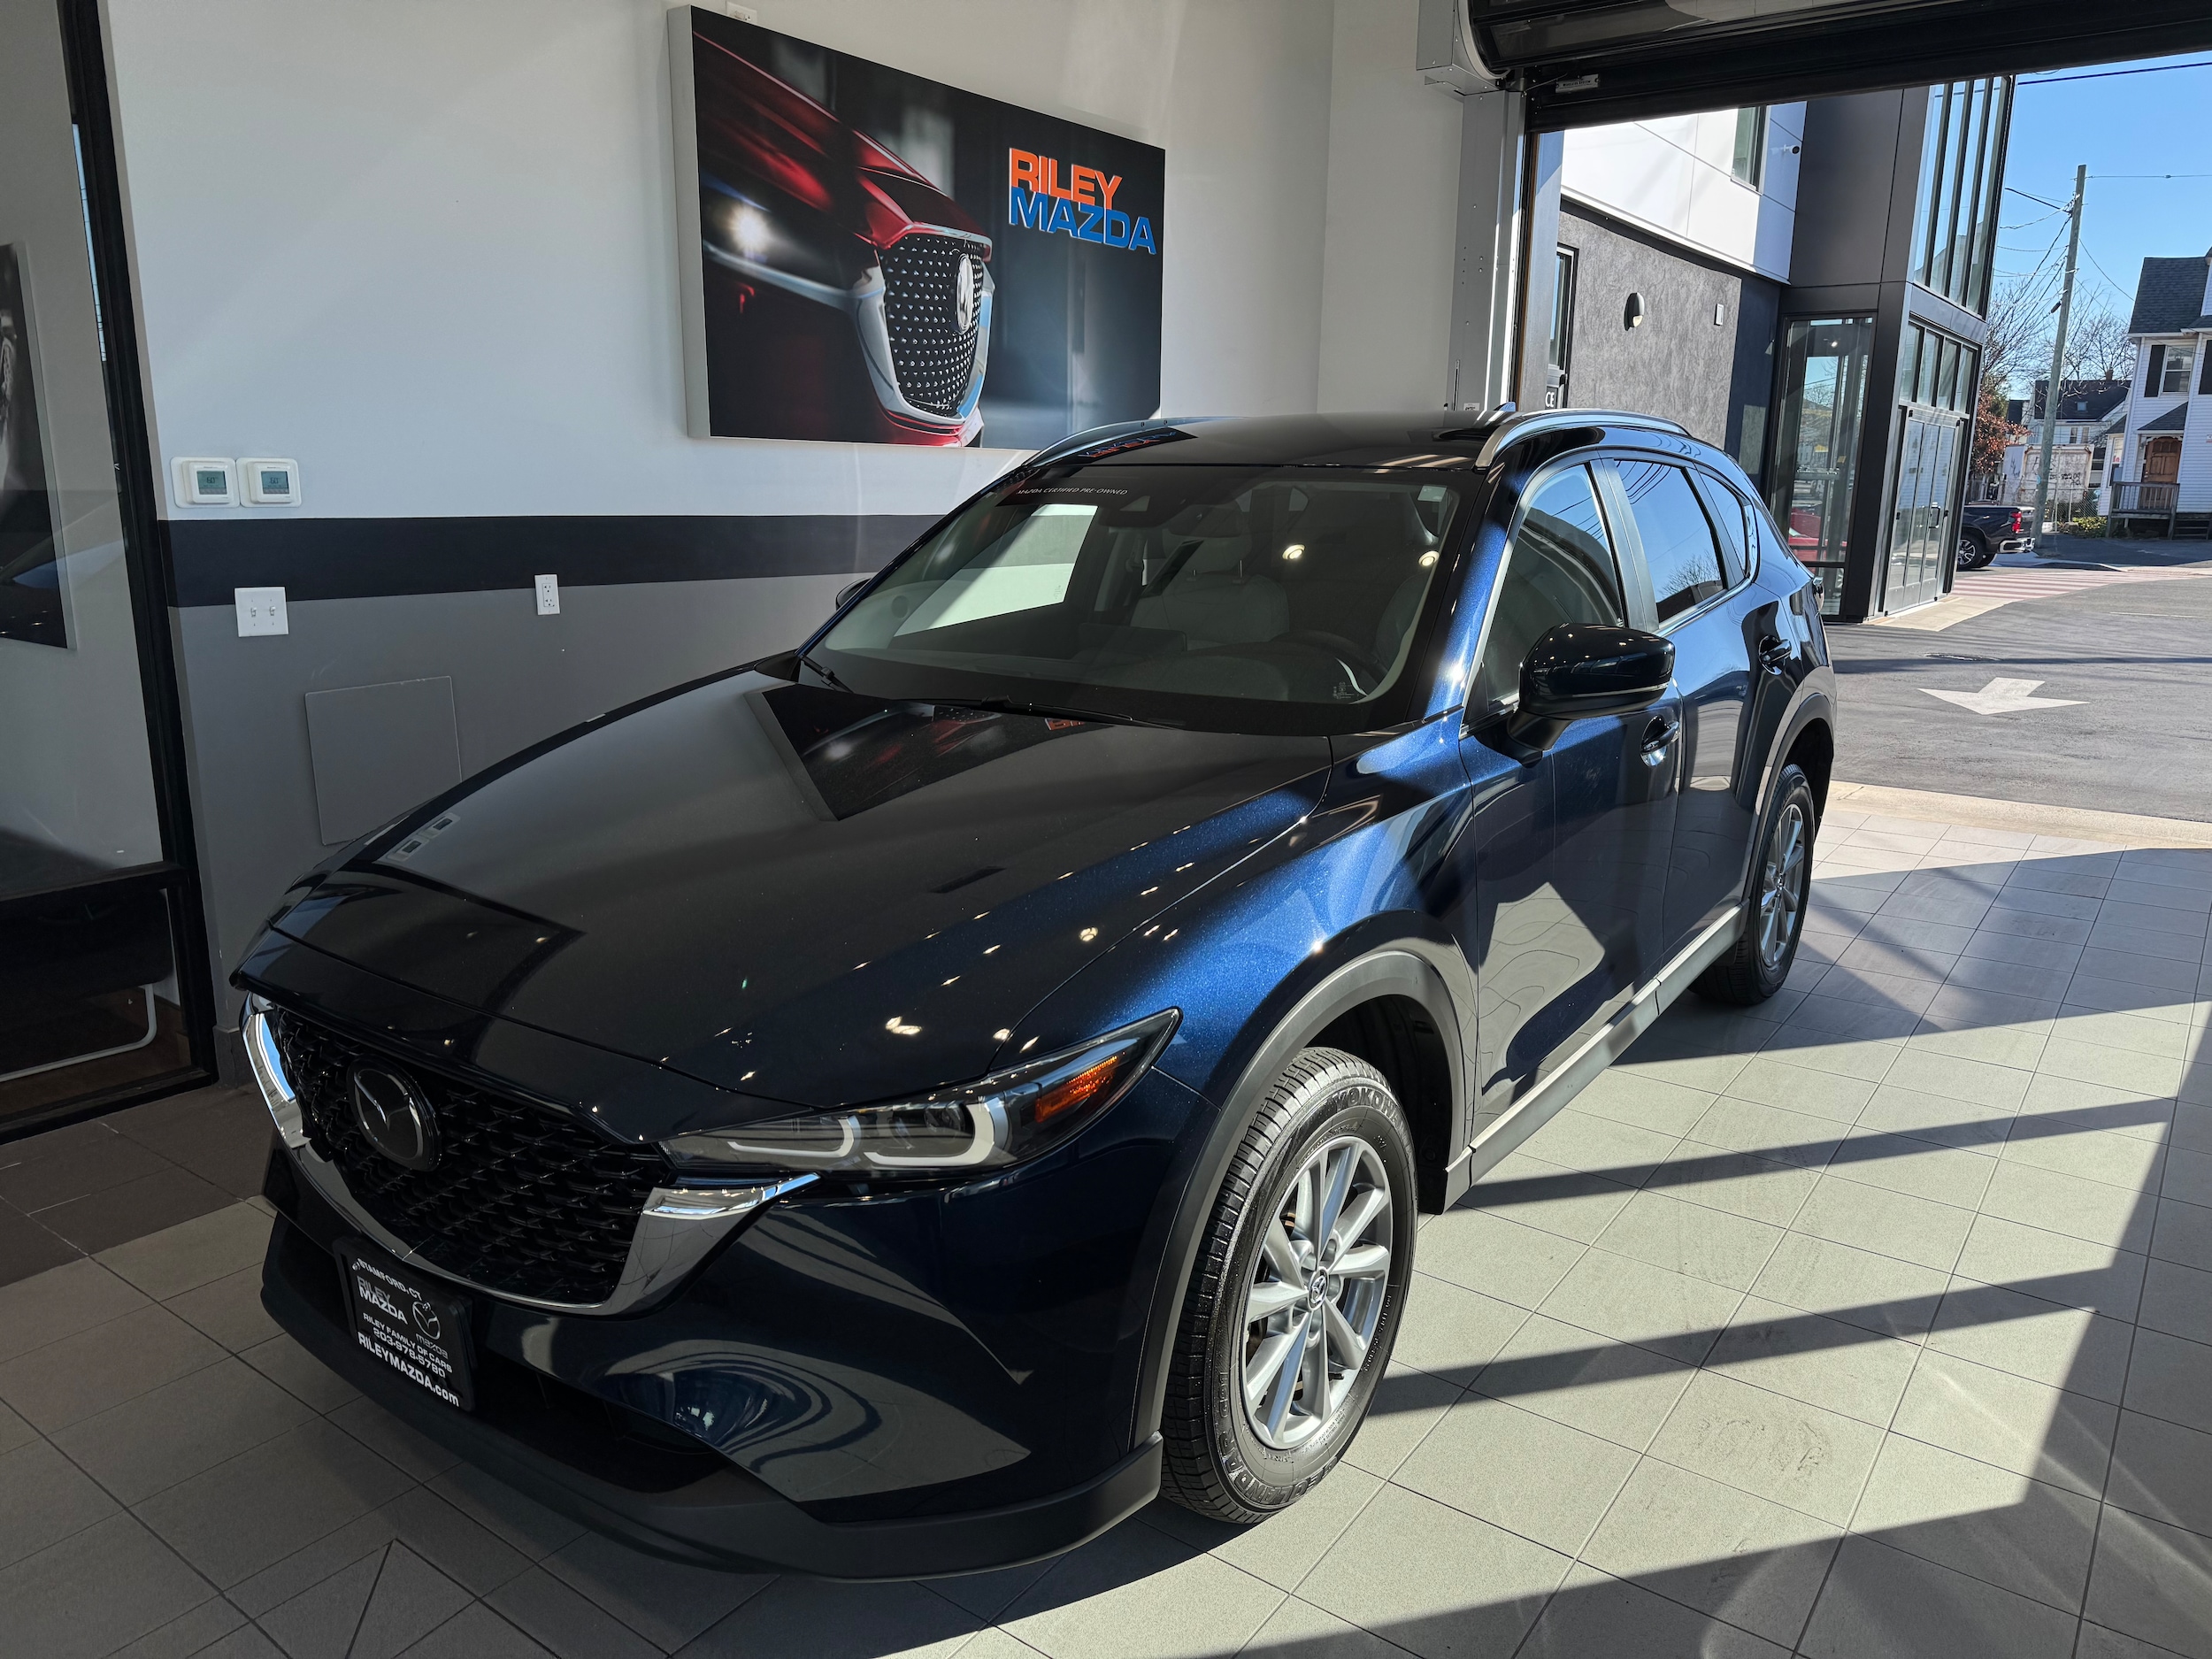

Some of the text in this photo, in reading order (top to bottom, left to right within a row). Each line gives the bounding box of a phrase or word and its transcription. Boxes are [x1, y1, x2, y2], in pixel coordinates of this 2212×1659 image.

[1009, 147, 1123, 211] RILEY
[1009, 186, 1157, 255] MAZDA
[357, 1275, 391, 1303] RILEY
[359, 1286, 409, 1325] MAZDA
[357, 1331, 459, 1407] RILEYMAZDA.com
[363, 1312, 452, 1373] RILEY FAMILY OF CARS
